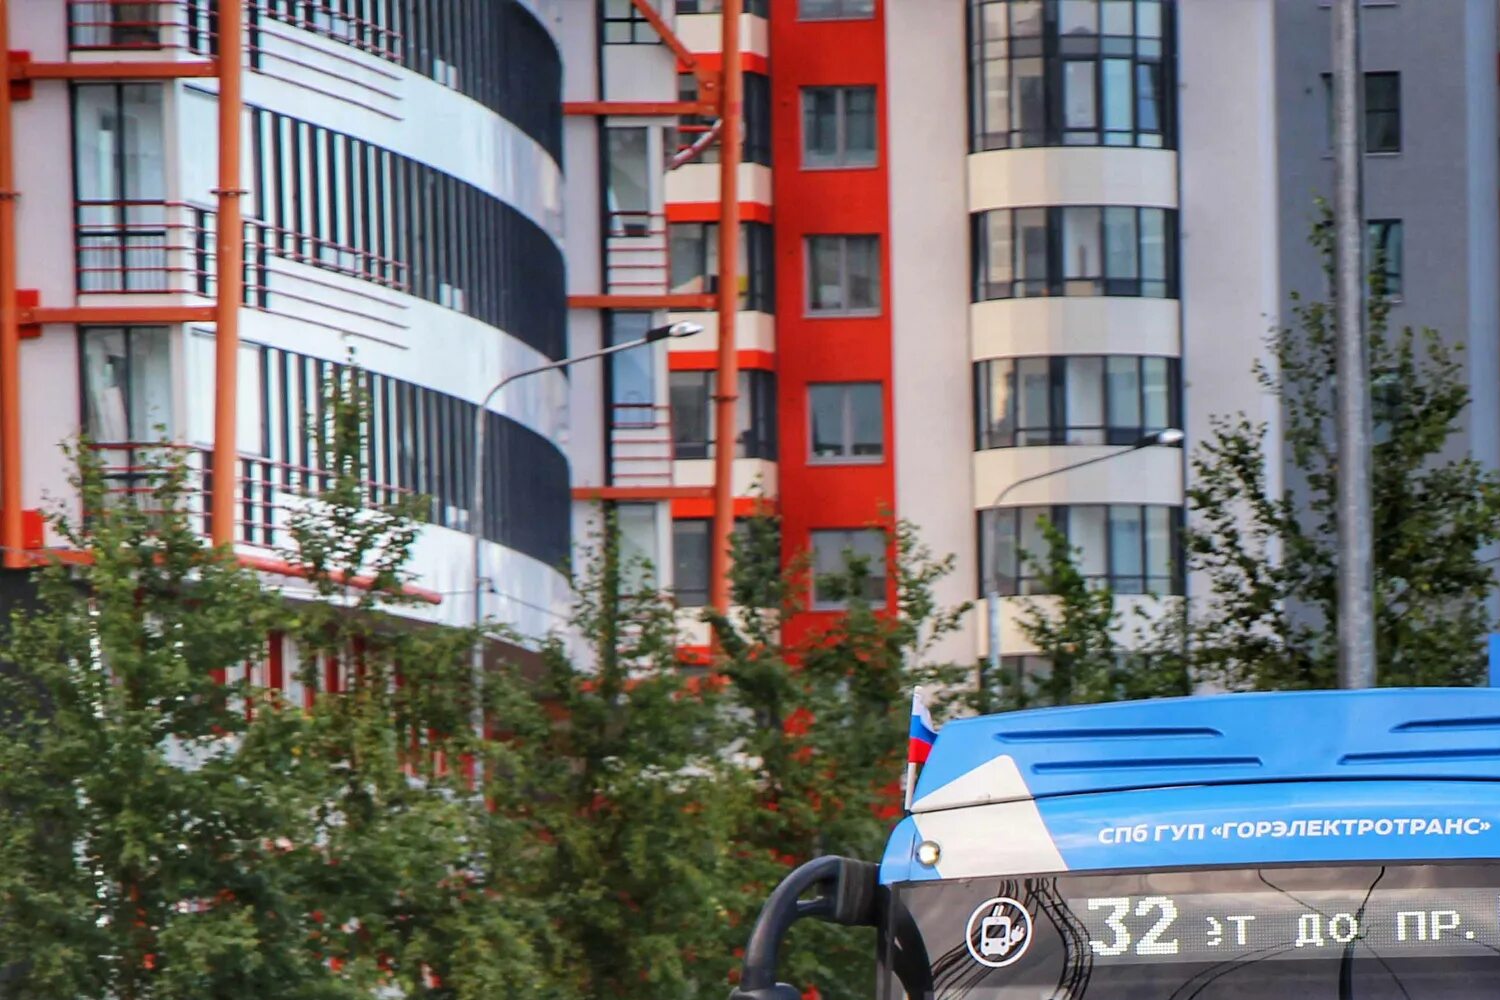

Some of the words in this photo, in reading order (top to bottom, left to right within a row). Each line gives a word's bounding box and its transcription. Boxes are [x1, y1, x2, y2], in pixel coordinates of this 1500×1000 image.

[1098, 824, 1148, 844] СПб
[1154, 823, 1205, 842] ГУП
[1211, 818, 1492, 839] «ГОРЭЛЕКТРОТРАНС»
[1087, 896, 1179, 956] 32
